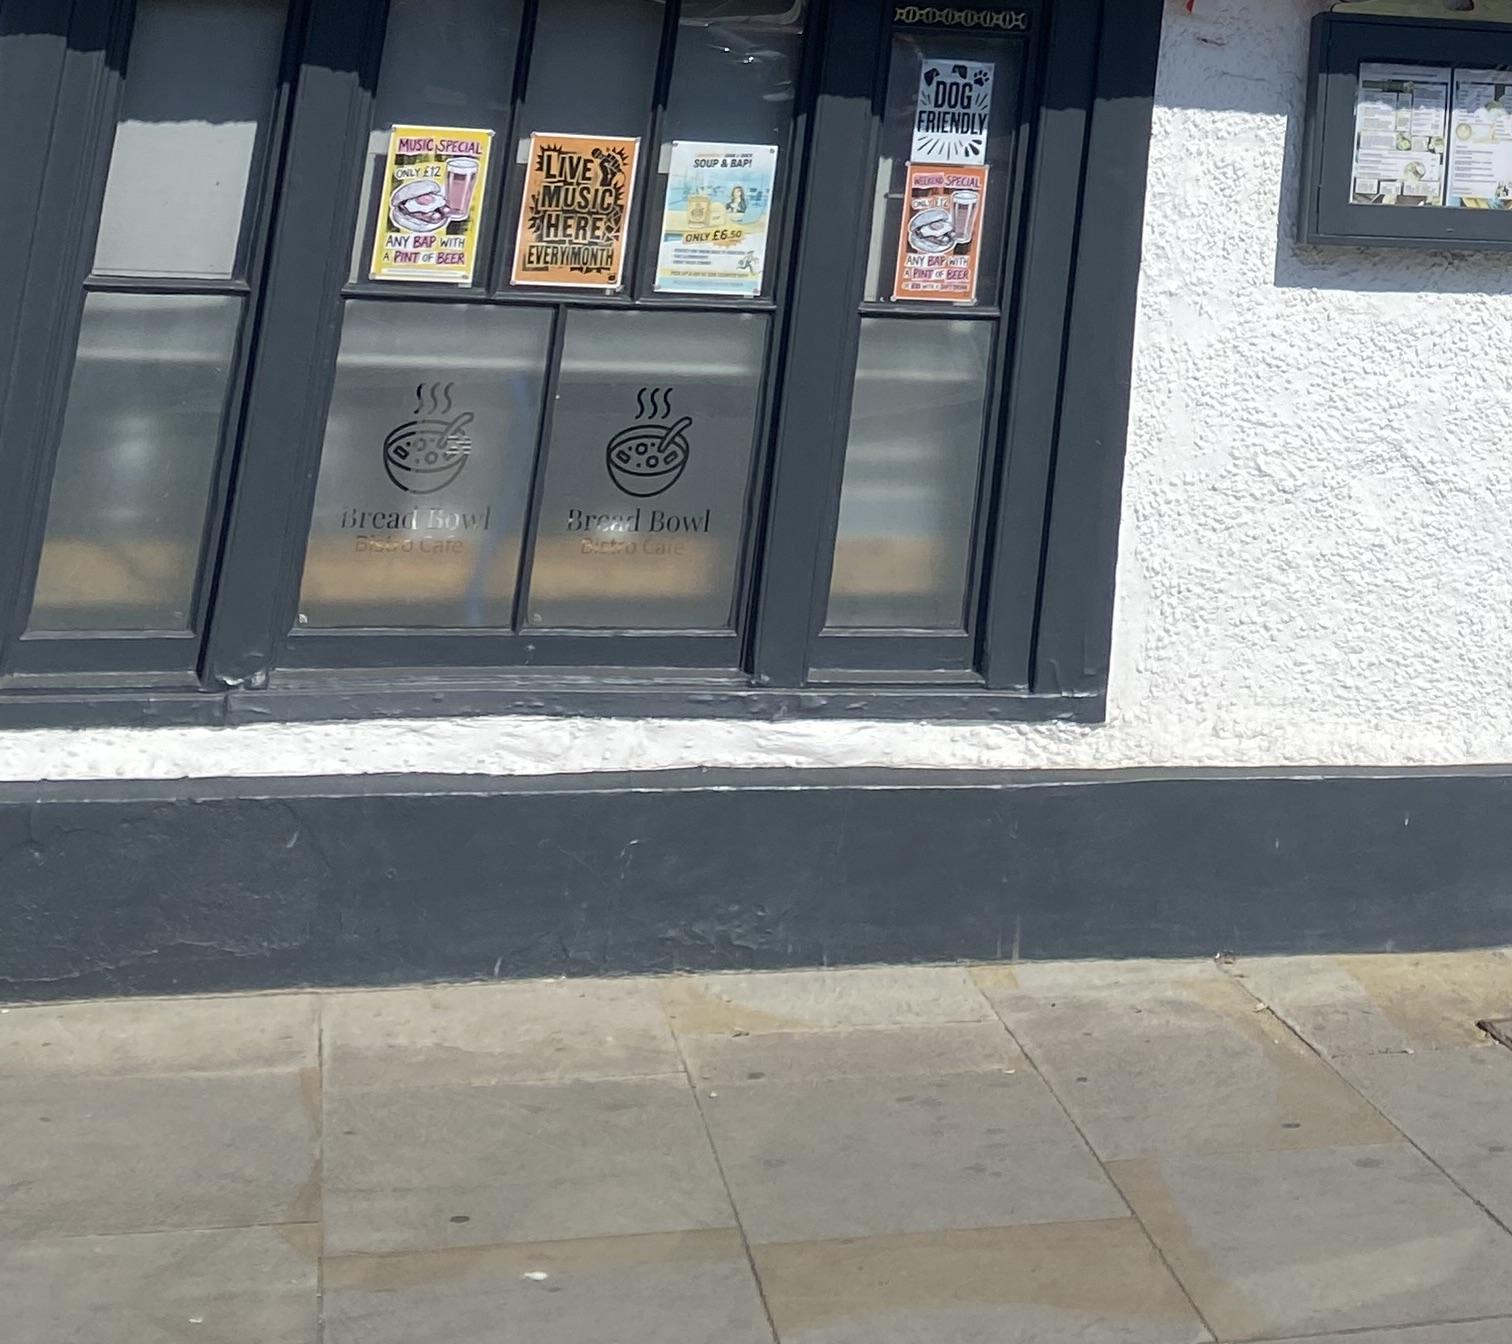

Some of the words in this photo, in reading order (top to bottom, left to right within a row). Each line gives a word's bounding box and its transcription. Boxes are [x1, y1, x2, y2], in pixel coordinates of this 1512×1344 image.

[934, 80, 974, 110] DOG
[917, 110, 988, 136] FRIENDLY
[398, 138, 435, 153] MUSIC
[437, 139, 483, 155] SPECIAL
[396, 167, 421, 178] ONLY
[422, 166, 442, 178] £12
[543, 153, 595, 182] LIVE
[693, 158, 719, 169] SOUP
[720, 158, 729, 169] &
[945, 175, 980, 188] SPECIAL
[540, 185, 614, 212] MUSIC
[544, 214, 604, 242] HERE
[685, 231, 711, 243] ONLY
[712, 228, 742, 241] £6.50
[386, 235, 411, 247] ANY
[413, 235, 437, 248] BAP
[440, 237, 466, 247] WITH
[383, 252, 390, 261] A
[394, 252, 420, 263] PINT
[422, 252, 434, 262] OF
[436, 252, 466, 265] BEER
[528, 244, 567, 265] EVERY
[570, 246, 614, 267] MONTH
[906, 255, 925, 266] ANY
[927, 255, 947, 267] BAP
[912, 269, 933, 280] PINT
[946, 269, 969, 281] BEER
[341, 506, 419, 530] Bread
[567, 507, 641, 532] Bread
[649, 508, 711, 533] Bowl
